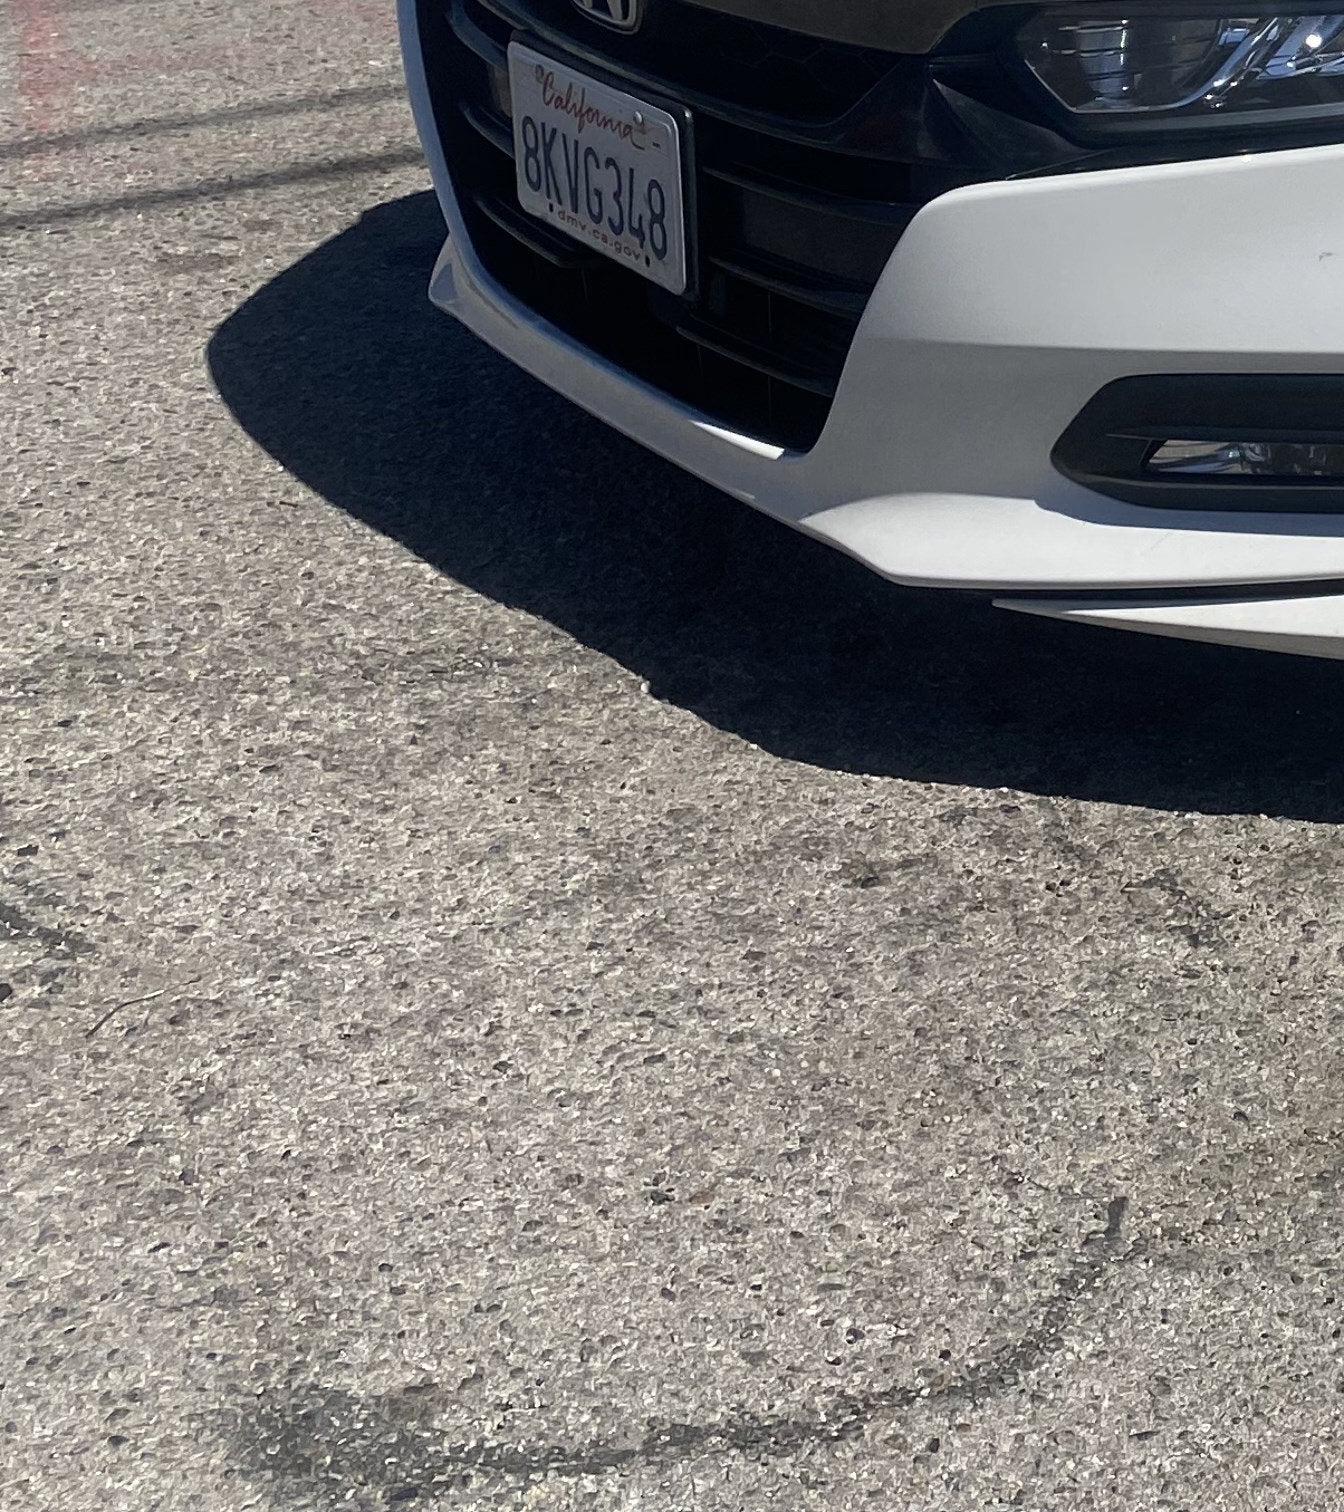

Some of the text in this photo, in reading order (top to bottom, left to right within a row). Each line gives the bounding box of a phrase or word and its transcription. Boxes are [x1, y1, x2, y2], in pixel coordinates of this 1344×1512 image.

[541, 70, 646, 152] California
[521, 114, 668, 261] 8KVG348
[557, 208, 642, 262] dmv.ca.gov
